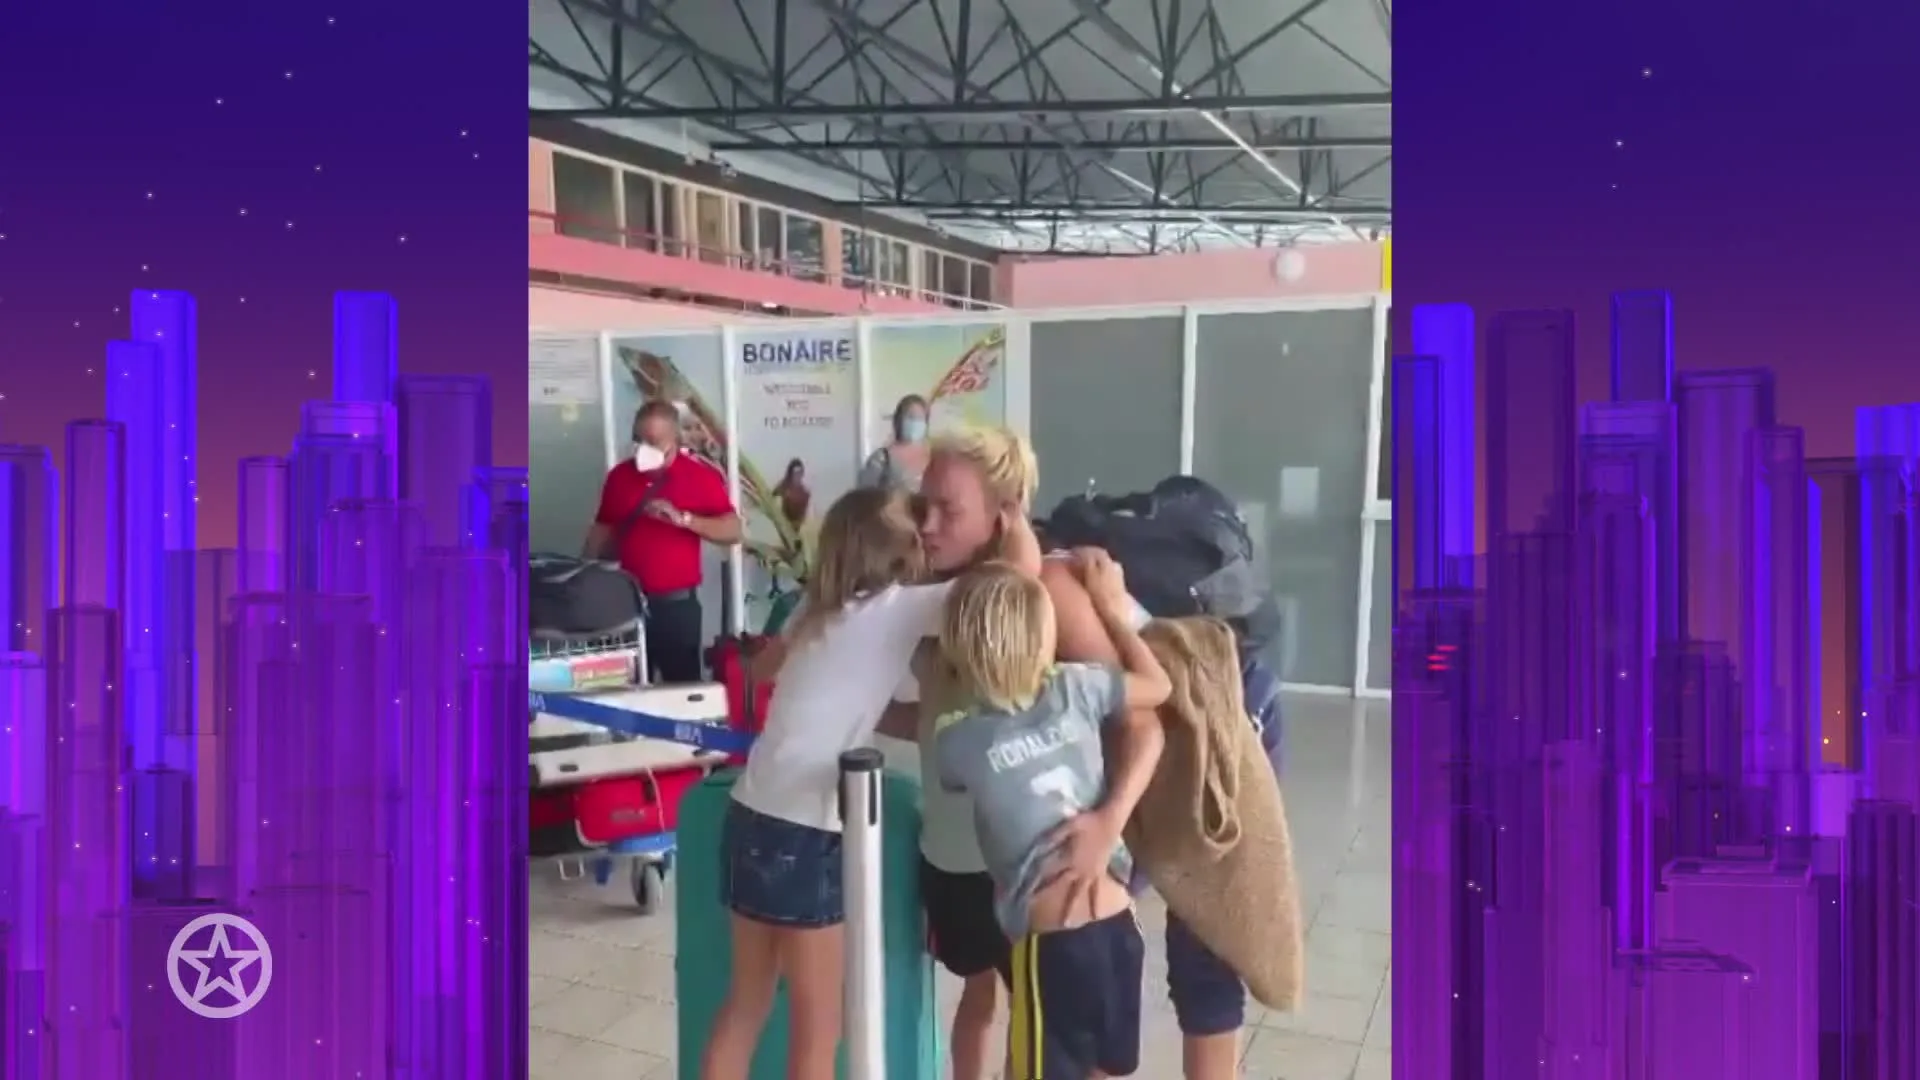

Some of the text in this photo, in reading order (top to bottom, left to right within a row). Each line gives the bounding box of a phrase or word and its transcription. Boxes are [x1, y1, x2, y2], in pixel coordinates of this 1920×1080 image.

[742, 339, 852, 363] BONAIRE
[986, 718, 1079, 774] RONALDO
[1030, 764, 1082, 819] 7
